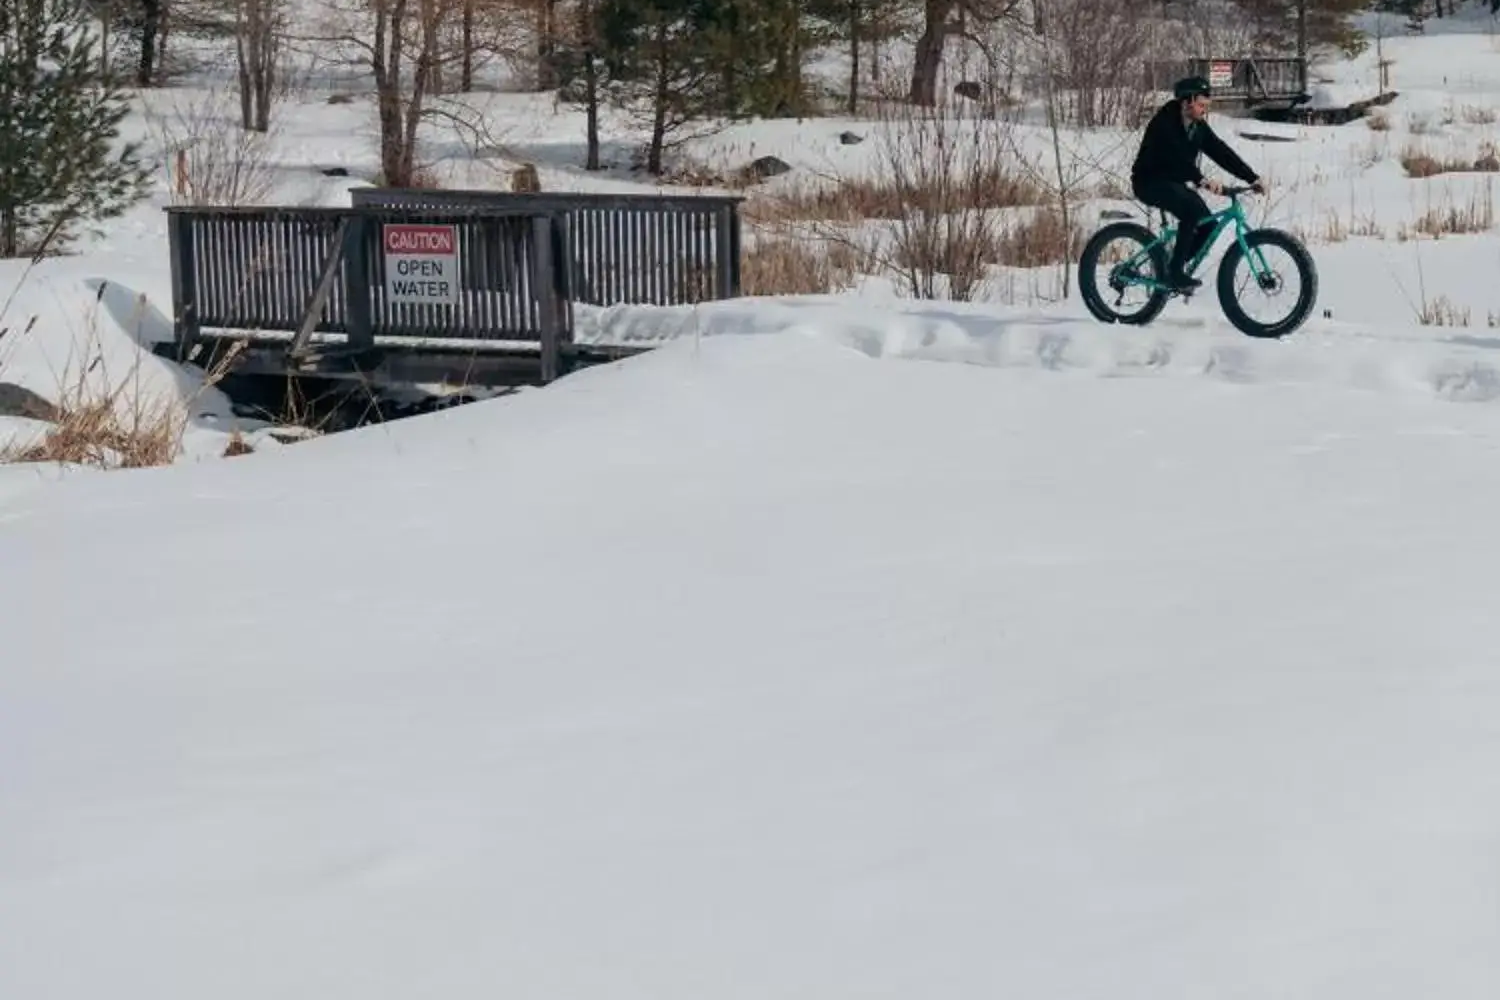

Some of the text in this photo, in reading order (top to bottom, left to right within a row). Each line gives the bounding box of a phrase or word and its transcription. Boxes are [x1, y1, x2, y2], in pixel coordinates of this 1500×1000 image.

[388, 231, 451, 249] CAUTION
[397, 259, 443, 277] OPEN
[391, 280, 449, 297] WATER
